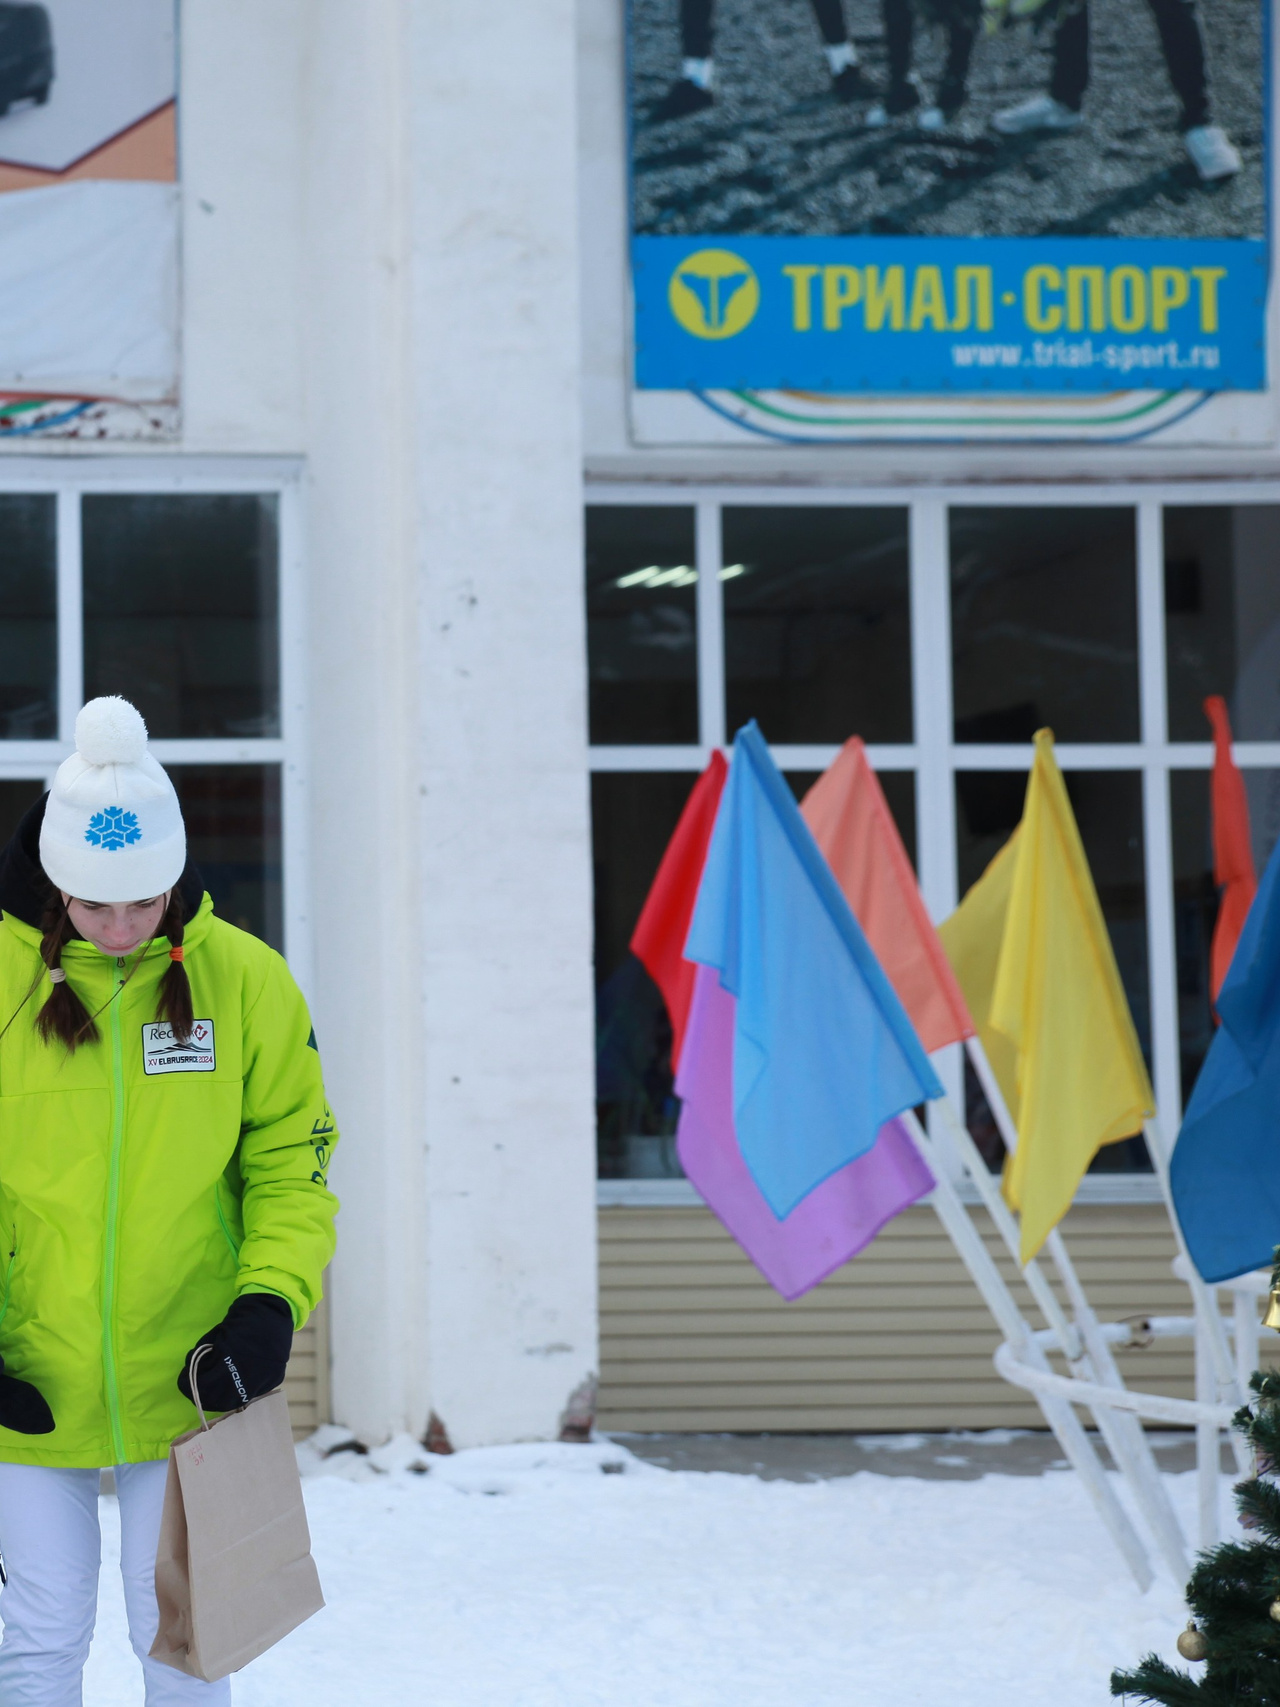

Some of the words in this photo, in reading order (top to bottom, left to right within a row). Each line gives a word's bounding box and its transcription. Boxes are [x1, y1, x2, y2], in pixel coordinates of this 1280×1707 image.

[951, 337, 1221, 375] www.trial-sport.ru
[148, 1058, 158, 1067] XV
[223, 1356, 249, 1403] NORDSKI
